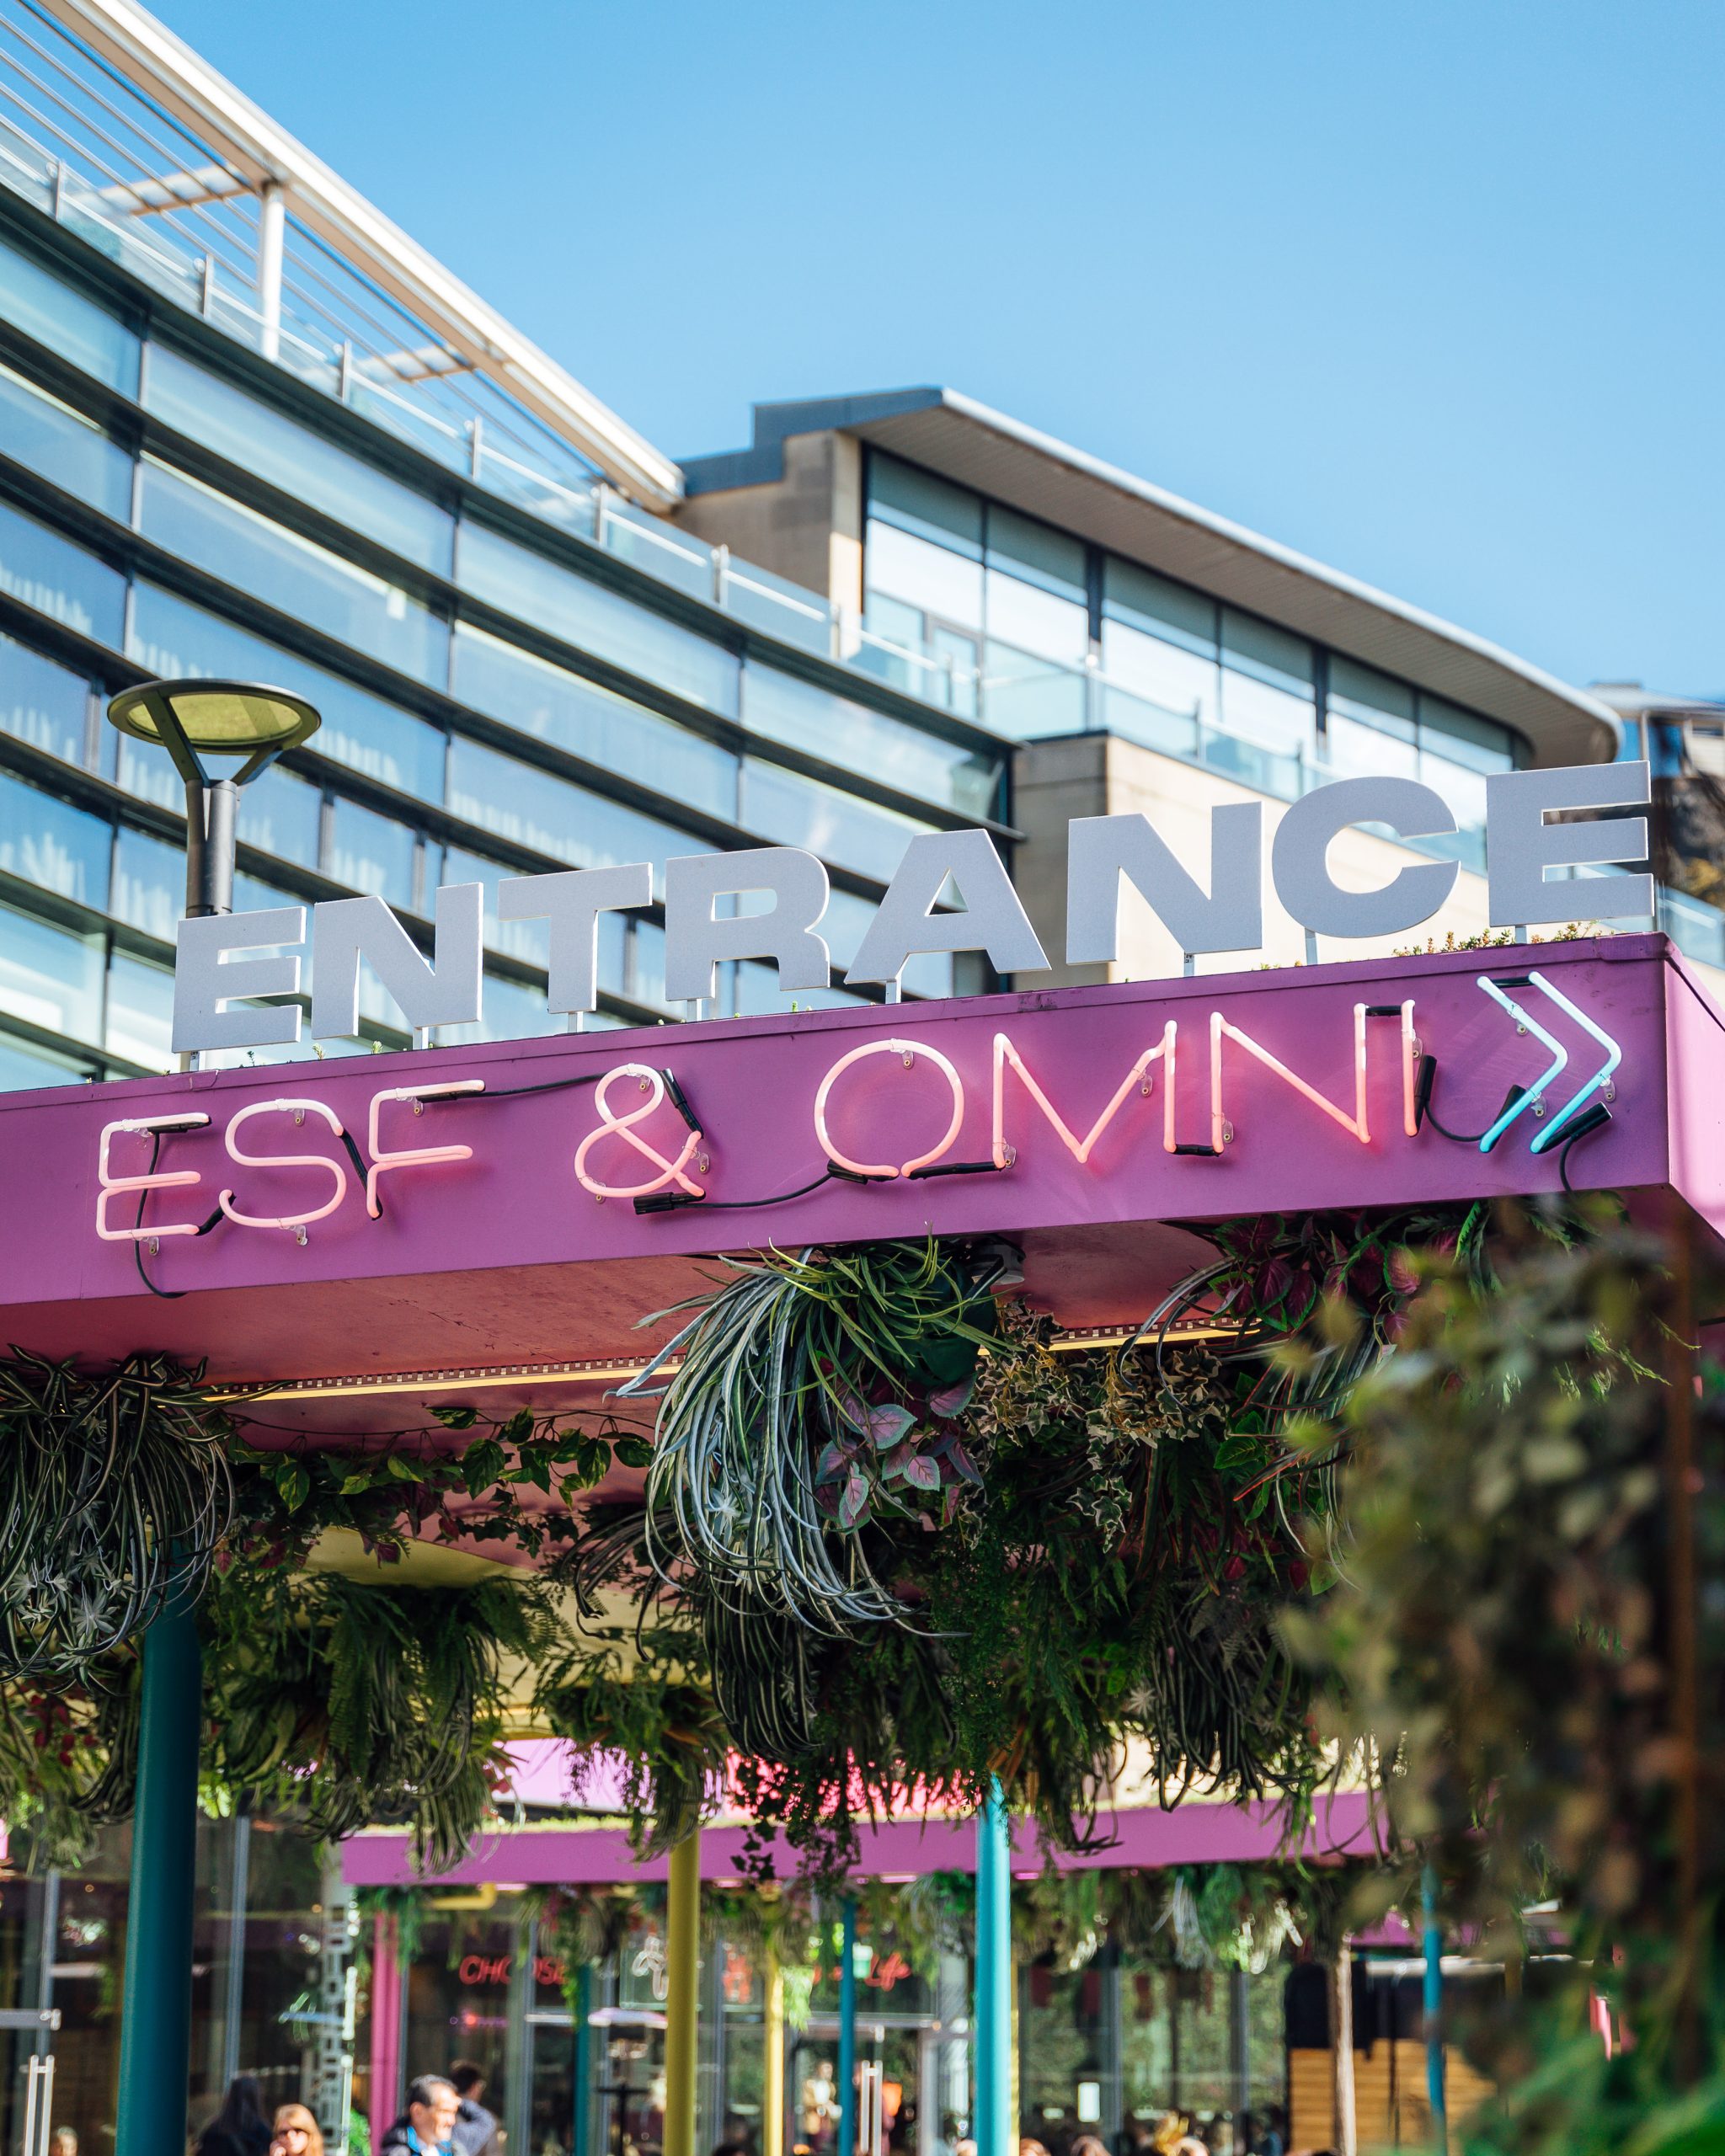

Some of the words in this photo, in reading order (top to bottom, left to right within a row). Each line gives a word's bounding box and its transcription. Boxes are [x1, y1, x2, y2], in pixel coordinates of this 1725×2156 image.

[172, 760, 1654, 1054] ENTRANCE
[96, 1080, 486, 1242] ESF
[574, 1063, 706, 1199] &
[814, 1000, 1417, 1181] OMNI
